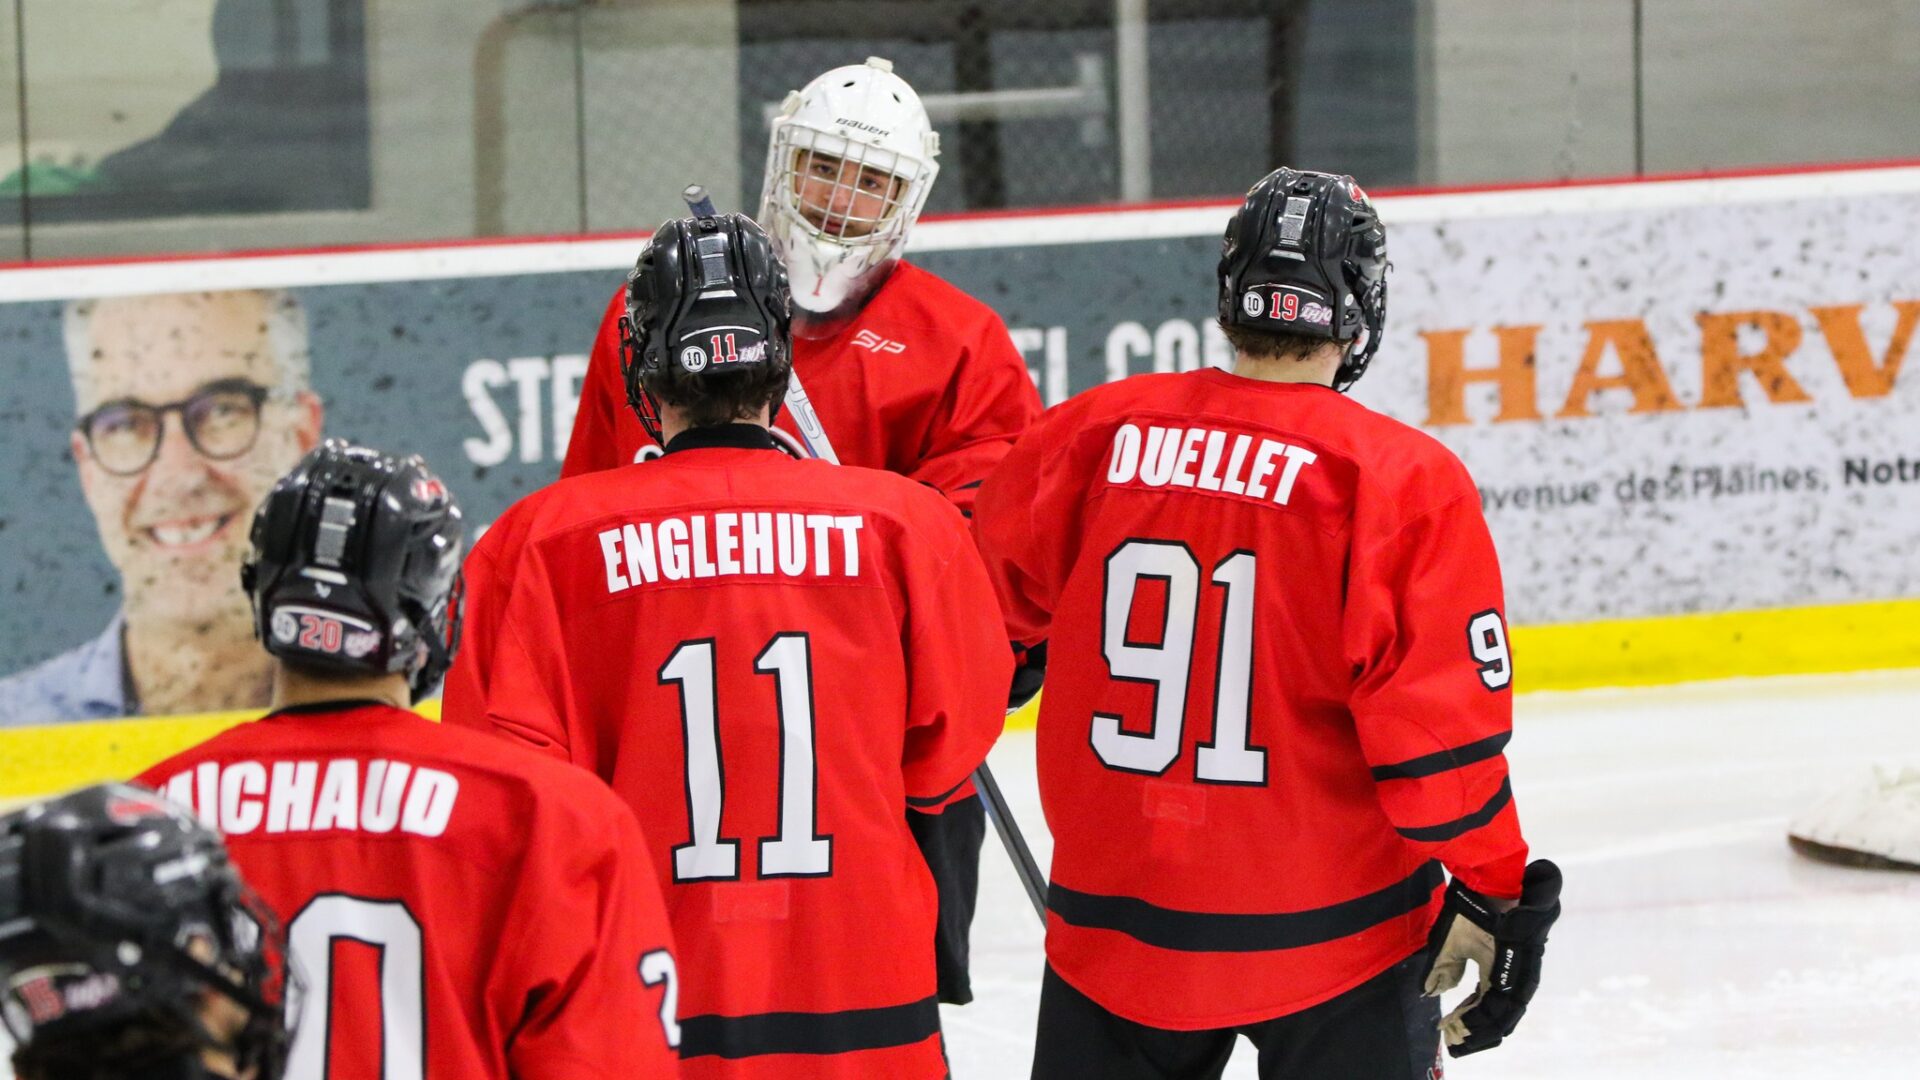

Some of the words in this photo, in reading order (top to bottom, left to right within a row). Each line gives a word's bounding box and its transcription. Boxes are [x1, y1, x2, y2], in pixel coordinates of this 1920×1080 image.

[1269, 292, 1299, 321] 19
[711, 333, 738, 364] 11
[1417, 298, 1920, 427] HARV
[1107, 424, 1318, 505] OUELLET
[599, 512, 863, 593] ENGLEHUTT
[299, 614, 342, 654] 20
[1089, 537, 1268, 787] 91
[658, 631, 833, 884] 11
[238, 892, 428, 1080] 0
